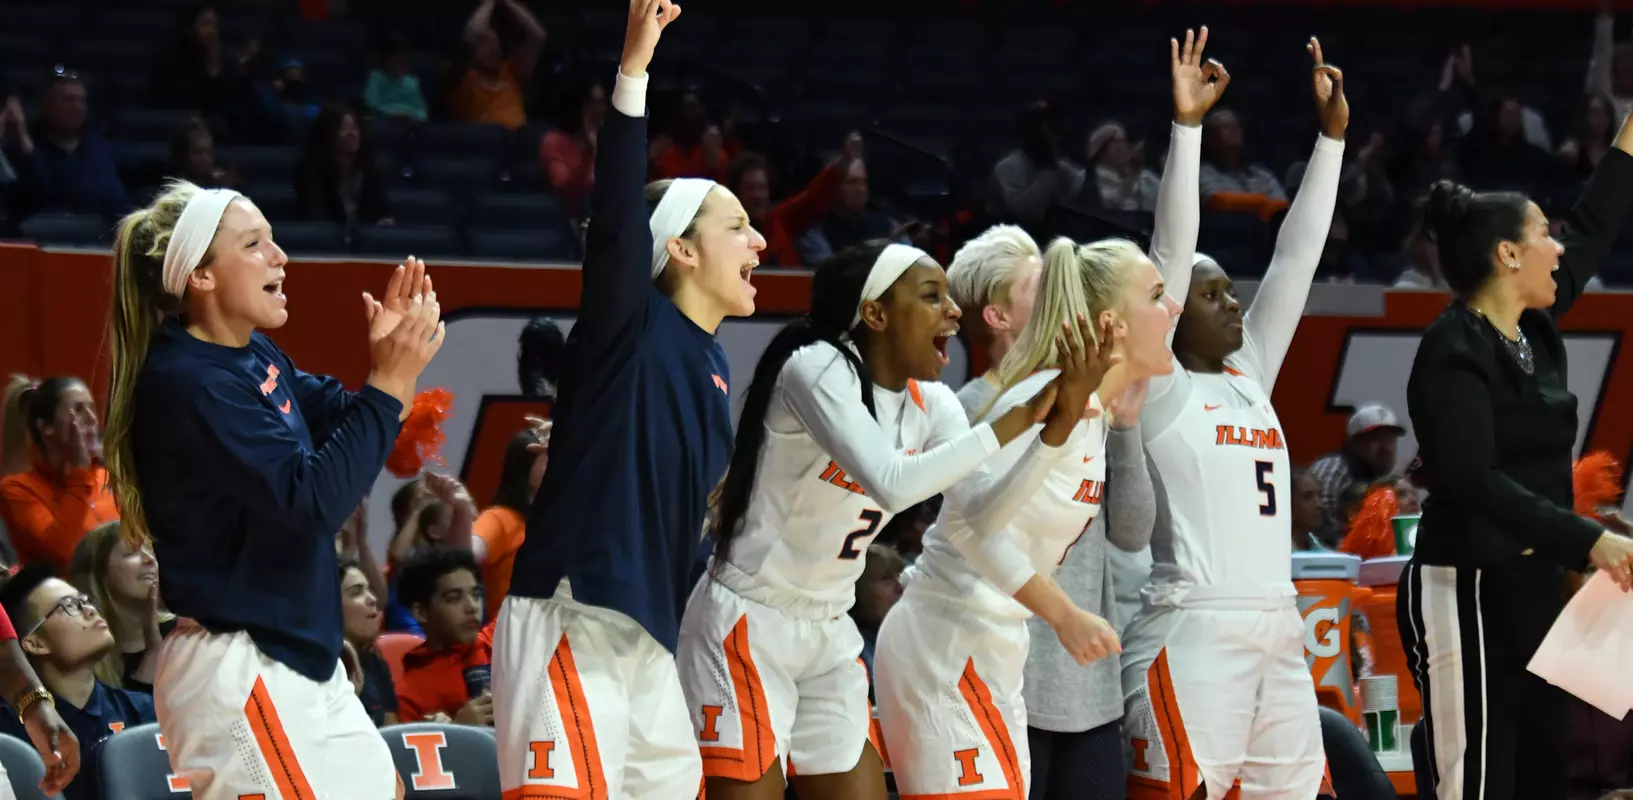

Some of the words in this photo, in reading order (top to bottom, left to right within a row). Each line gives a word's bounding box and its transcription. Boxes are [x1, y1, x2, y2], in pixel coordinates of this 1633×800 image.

[1254, 459, 1277, 516] 5
[837, 508, 883, 560] 2
[1303, 607, 1340, 658] G
[701, 705, 723, 742] I
[403, 731, 456, 790] I
[528, 741, 555, 779] I
[953, 748, 984, 786] I
